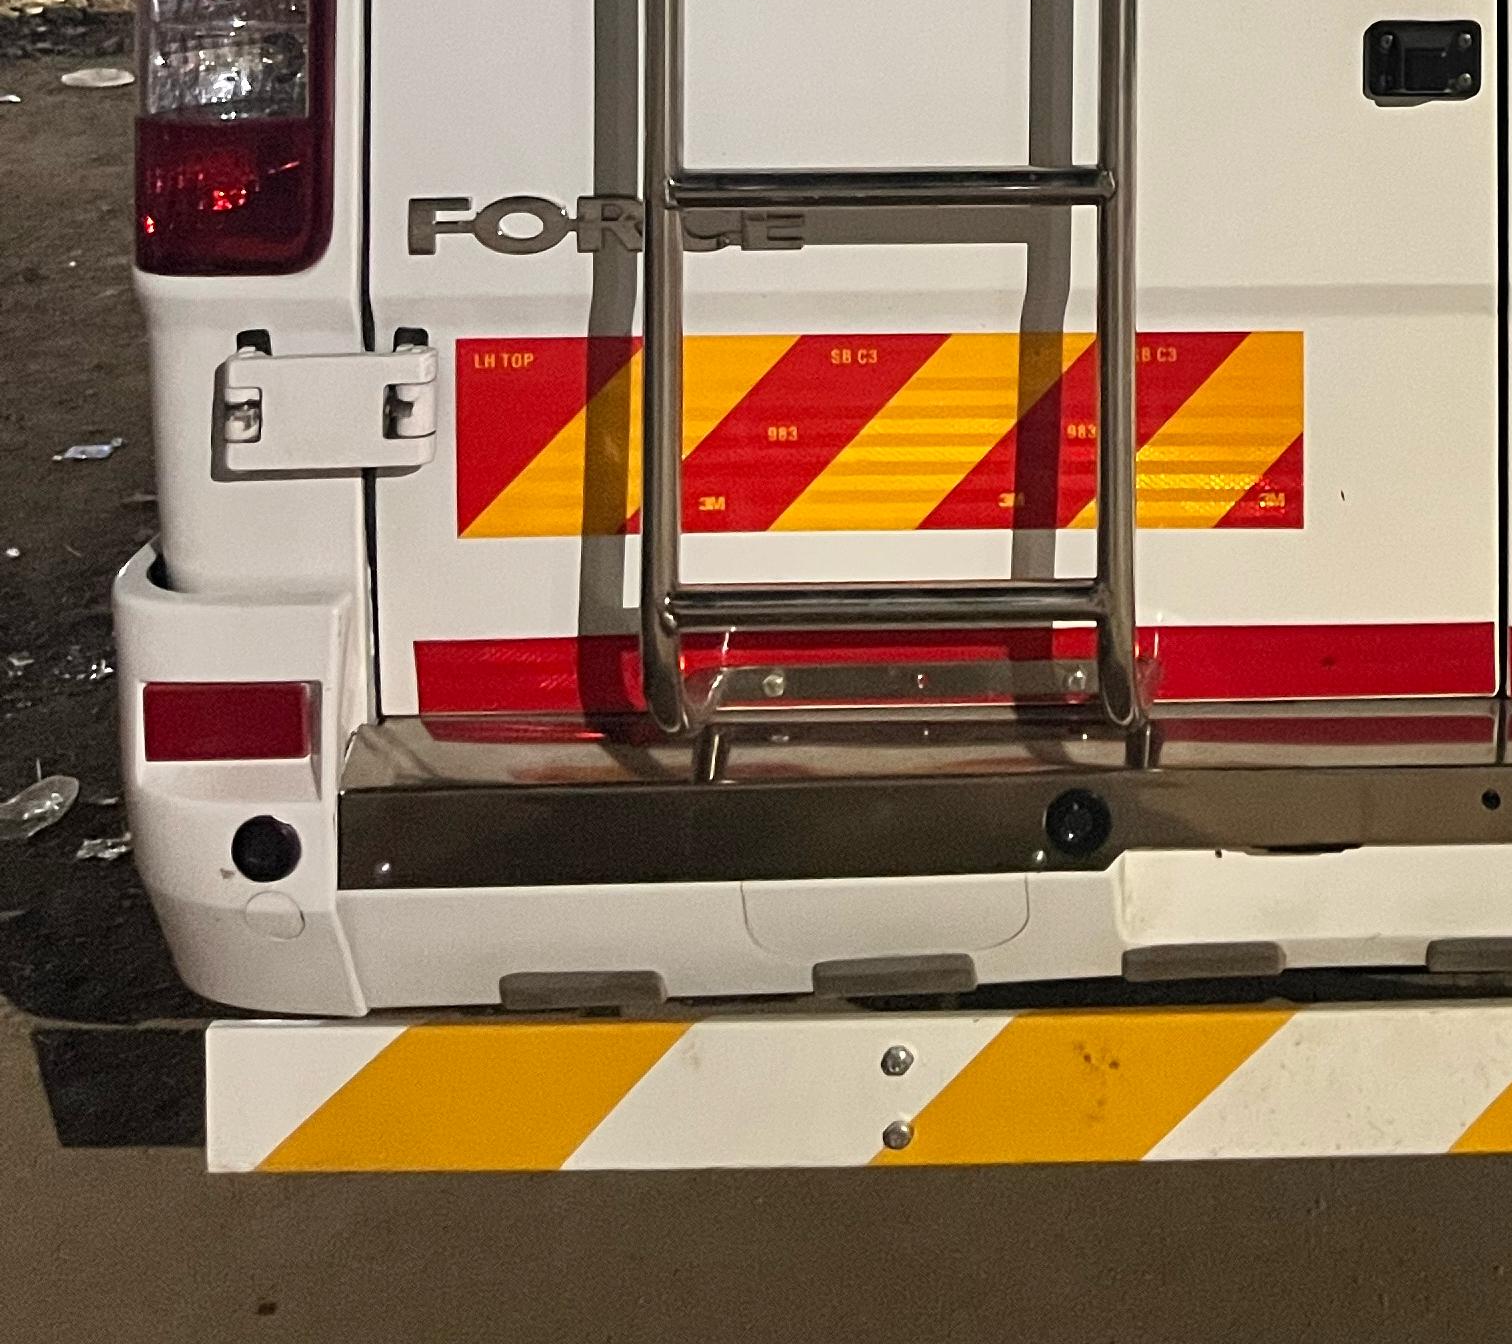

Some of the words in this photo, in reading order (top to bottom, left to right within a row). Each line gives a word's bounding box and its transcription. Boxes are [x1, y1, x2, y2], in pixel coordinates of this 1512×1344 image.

[474, 353, 496, 369] LH
[502, 352, 534, 368] TOP
[831, 348, 851, 364] SB
[857, 348, 878, 365] C3
[1157, 346, 1178, 362] C3
[698, 496, 726, 512] 3M
[1258, 492, 1286, 508] 3M
